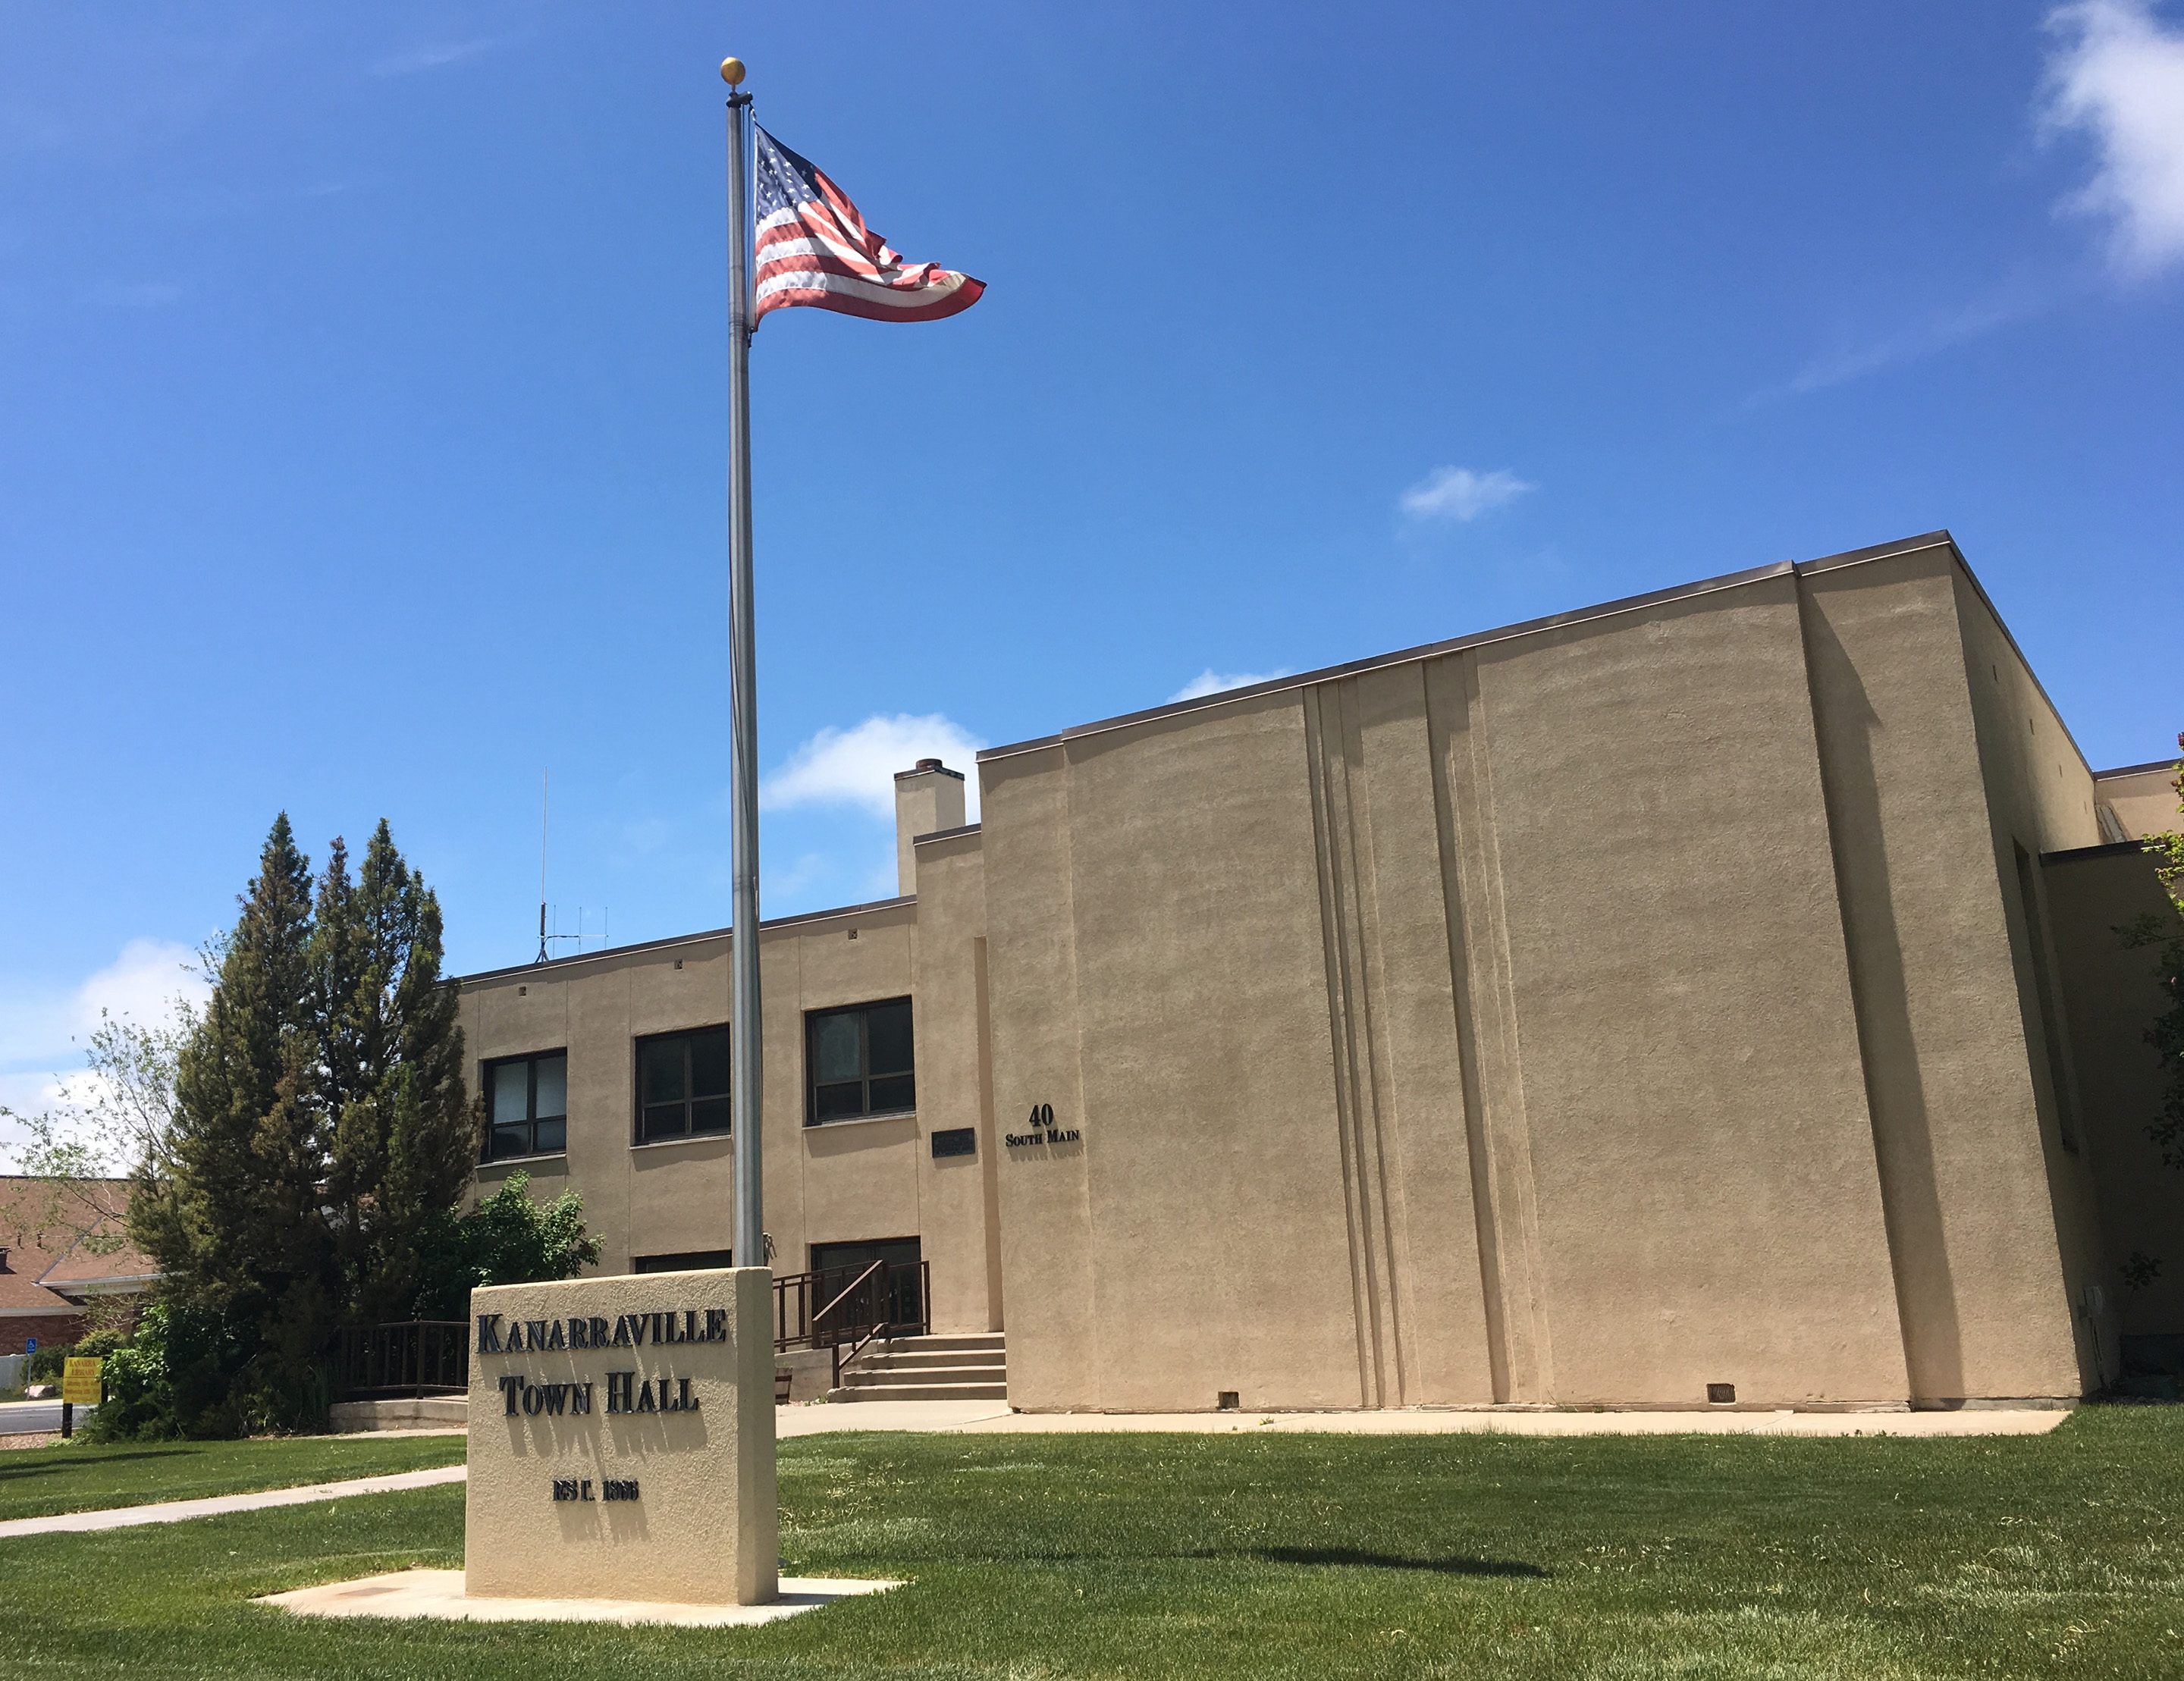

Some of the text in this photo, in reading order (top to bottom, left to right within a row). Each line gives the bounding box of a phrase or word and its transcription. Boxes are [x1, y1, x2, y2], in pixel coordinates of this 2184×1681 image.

[1028, 1103, 1053, 1127] 40
[1006, 1130, 1079, 1147] SOUTH MAIN
[476, 1309, 726, 1354] KANARRAVILLE
[499, 1371, 699, 1417] TOWN HALL
[552, 1479, 595, 1501] EST.
